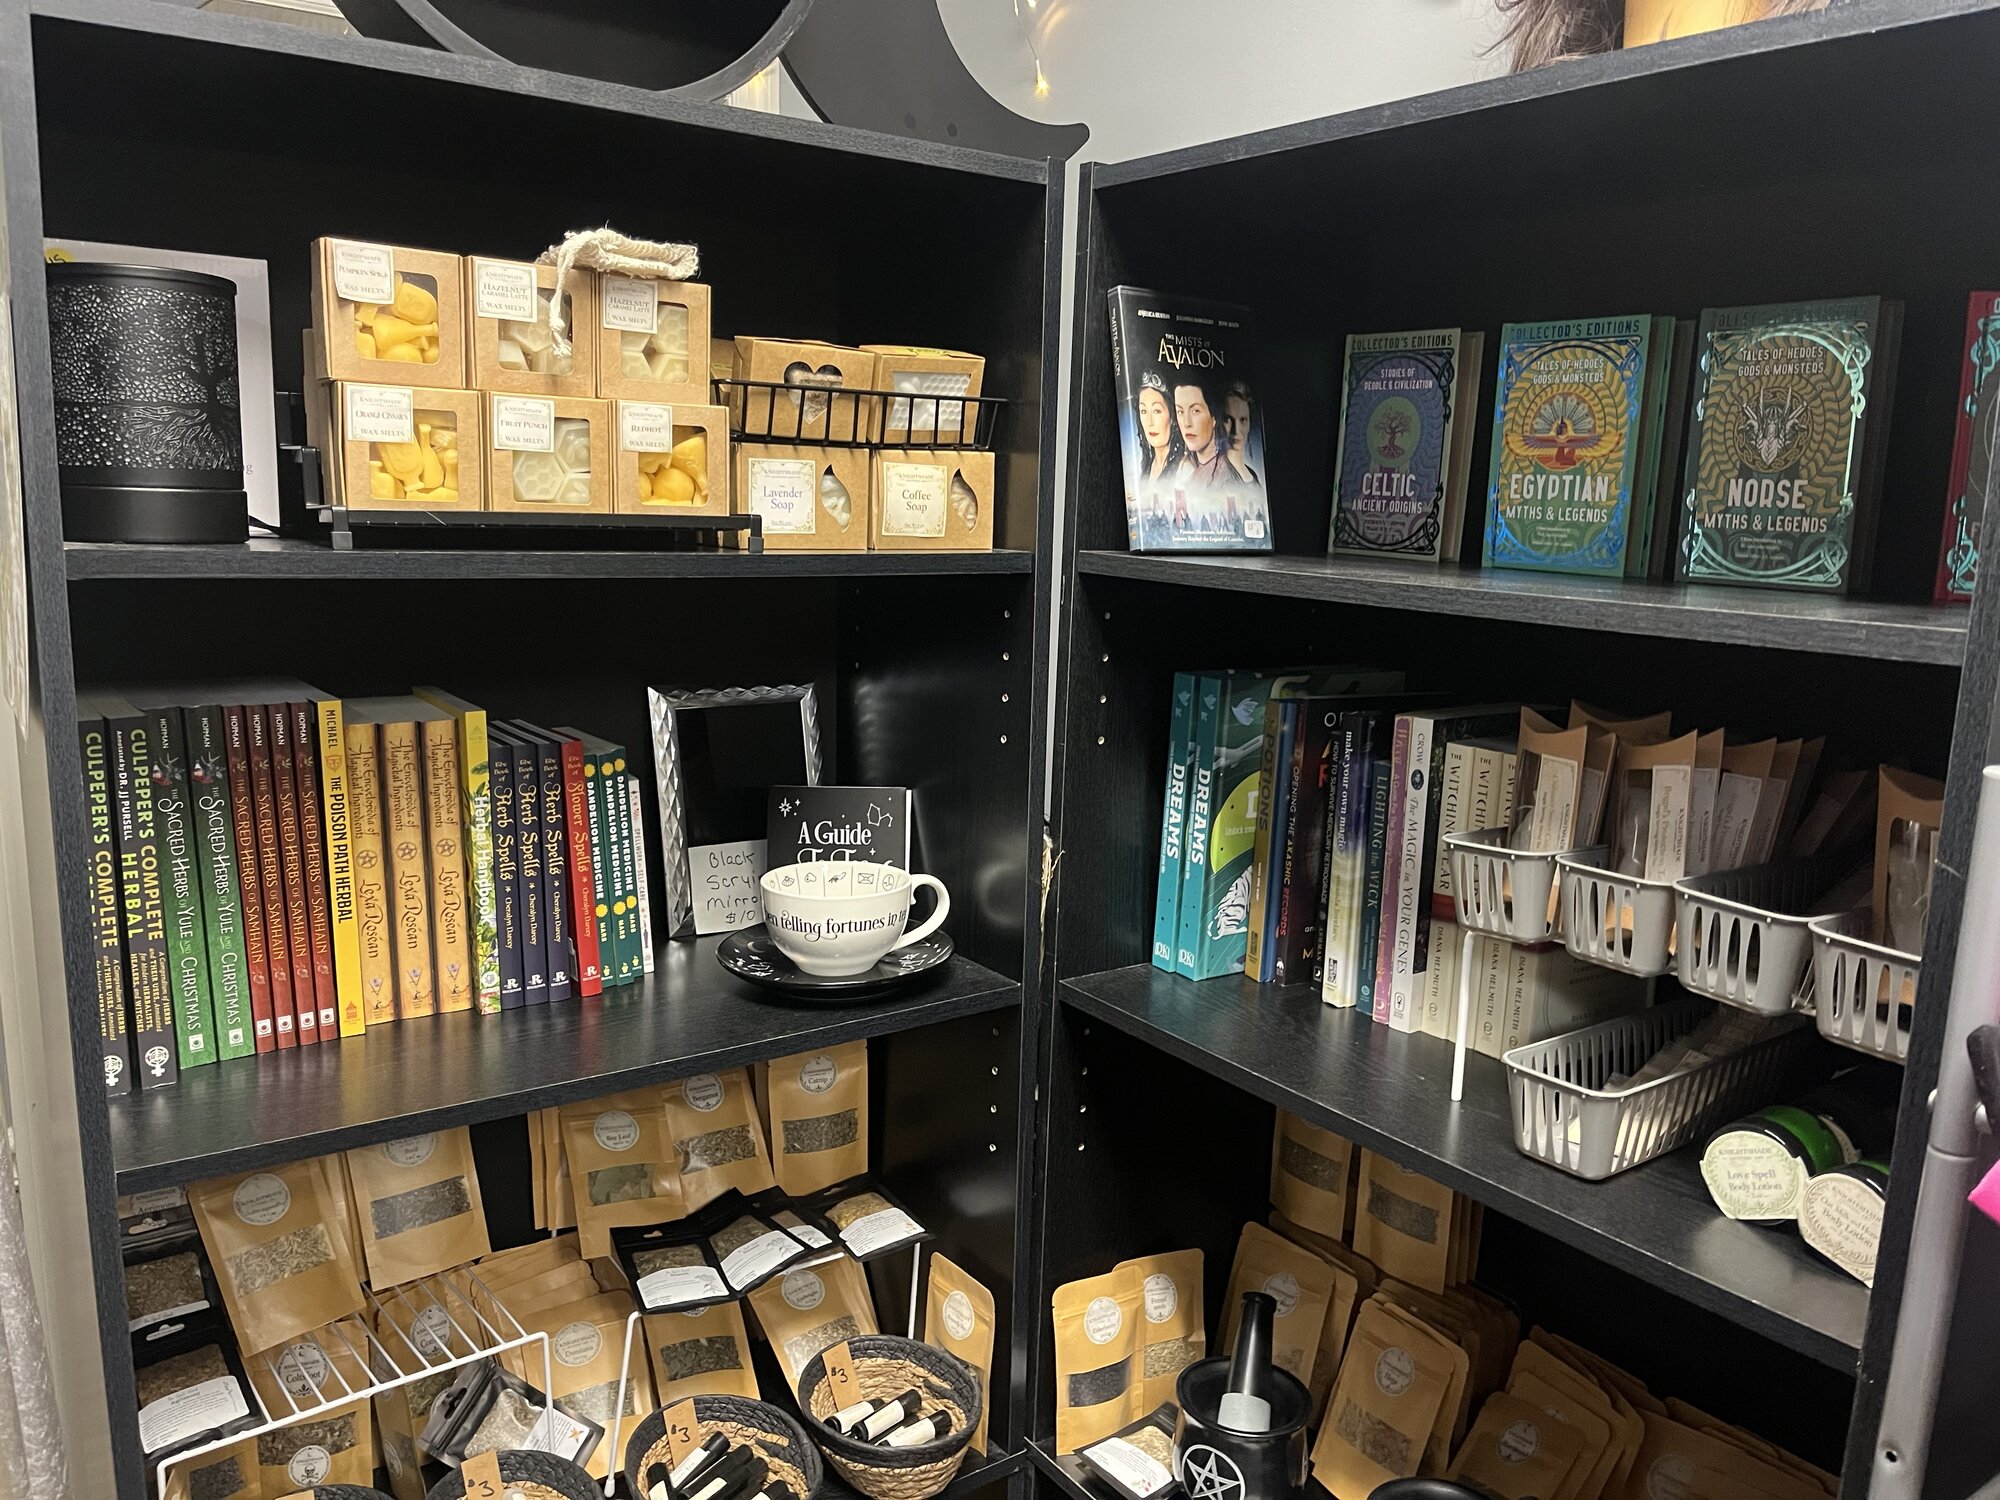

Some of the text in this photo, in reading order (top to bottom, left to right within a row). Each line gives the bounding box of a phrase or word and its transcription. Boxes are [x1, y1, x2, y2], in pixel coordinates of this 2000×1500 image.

[339, 265, 368, 276] PUMPKIN
[482, 290, 528, 301] CARAMEL LATTE
[483, 283, 527, 294] HAZELNUT
[505, 304, 526, 312] MELTS
[1158, 338, 1224, 370] AVALON
[1176, 335, 1202, 348] MISTS
[1352, 334, 1453, 350] COLLECTOR'S EDITIONS
[1741, 348, 1769, 361] TALES
[1773, 348, 1783, 360] OF
[1381, 367, 1415, 378] STORIES OF
[1738, 362, 1824, 377] GODS & MONSTERS
[1394, 379, 1433, 390] CIVILIZATION
[501, 419, 548, 430] FRUIT PUNCH
[631, 424, 662, 433] REDHOT
[763, 485, 803, 499] Lavender
[902, 489, 931, 501] Coffee
[1362, 472, 1416, 497] CELTIC
[1510, 474, 1609, 502] EGYPTIAN
[1727, 478, 1809, 509] NORSE
[770, 498, 794, 513] Soap
[906, 501, 928, 514] Soap
[1352, 498, 1423, 514] ANCIENT ORIGINS
[1506, 506, 1608, 522] MYTHS & LEGENDS
[326, 709, 337, 748] MICHAEL
[1345, 731, 1354, 760] make
[1416, 732, 1425, 763] CROW
[85, 732, 110, 845] CULPEPER'S
[116, 730, 133, 841] Annotated by DR. JJ PURSELL
[399, 737, 419, 830] The Encyclopedia of
[1259, 735, 1274, 831] POTIONS
[1342, 762, 1351, 789] your
[171, 788, 179, 800] THE
[235, 796, 252, 846] SACRED
[1167, 763, 1185, 859] DREAMS
[1320, 740, 1339, 904] HOW TO SURVIVE MERCURY RETROGRADE
[1372, 775, 1388, 849] LIGHTING
[130, 729, 164, 941] CULPEPER'S COMPLETE
[158, 798, 185, 856] SACRED
[493, 785, 517, 881] Herb Spells
[566, 780, 591, 873] Flower Spells
[797, 821, 872, 846] A Guide
[1337, 816, 1347, 850] magic
[330, 776, 353, 924] THE POISON PATH HERBAL
[474, 796, 494, 920] Herbal Handbook
[587, 782, 608, 943] DANDELION MEDICINE MARS
[634, 828, 647, 901] SPELLWORK SELF-CARE
[709, 852, 756, 868] Black
[1280, 768, 1300, 935] OPENING THE AKASHIC RECORDS
[171, 858, 190, 899] HERBS
[240, 849, 256, 890] HERBS
[706, 873, 760, 890] Scryi
[95, 850, 118, 948] COMPLETE
[121, 852, 144, 939] HERBAL
[248, 892, 256, 903] OF
[399, 870, 421, 900] Lexa
[1368, 870, 1380, 907] WICK
[1397, 797, 1419, 975] The MAGIC in YOUR GENES
[504, 897, 512, 926] Cheralyn
[707, 896, 758, 911] mirro
[725, 910, 756, 924] $10
[177, 906, 195, 938] YULE
[246, 905, 264, 963] SAMHAIN
[781, 909, 898, 942] telling fortunes in
[1155, 941, 1170, 959] DK
[1431, 926, 1444, 997] DIANA HELMUTH
[159, 958, 169, 995] Compendium
[180, 956, 201, 1030] CHRISTMAS
[163, 1002, 171, 1025] HERBS
[1727, 1170, 1776, 1182] Love Spell
[1729, 1183, 1782, 1192] Body Lotion
[286, 1371, 321, 1384] Coltsoot
